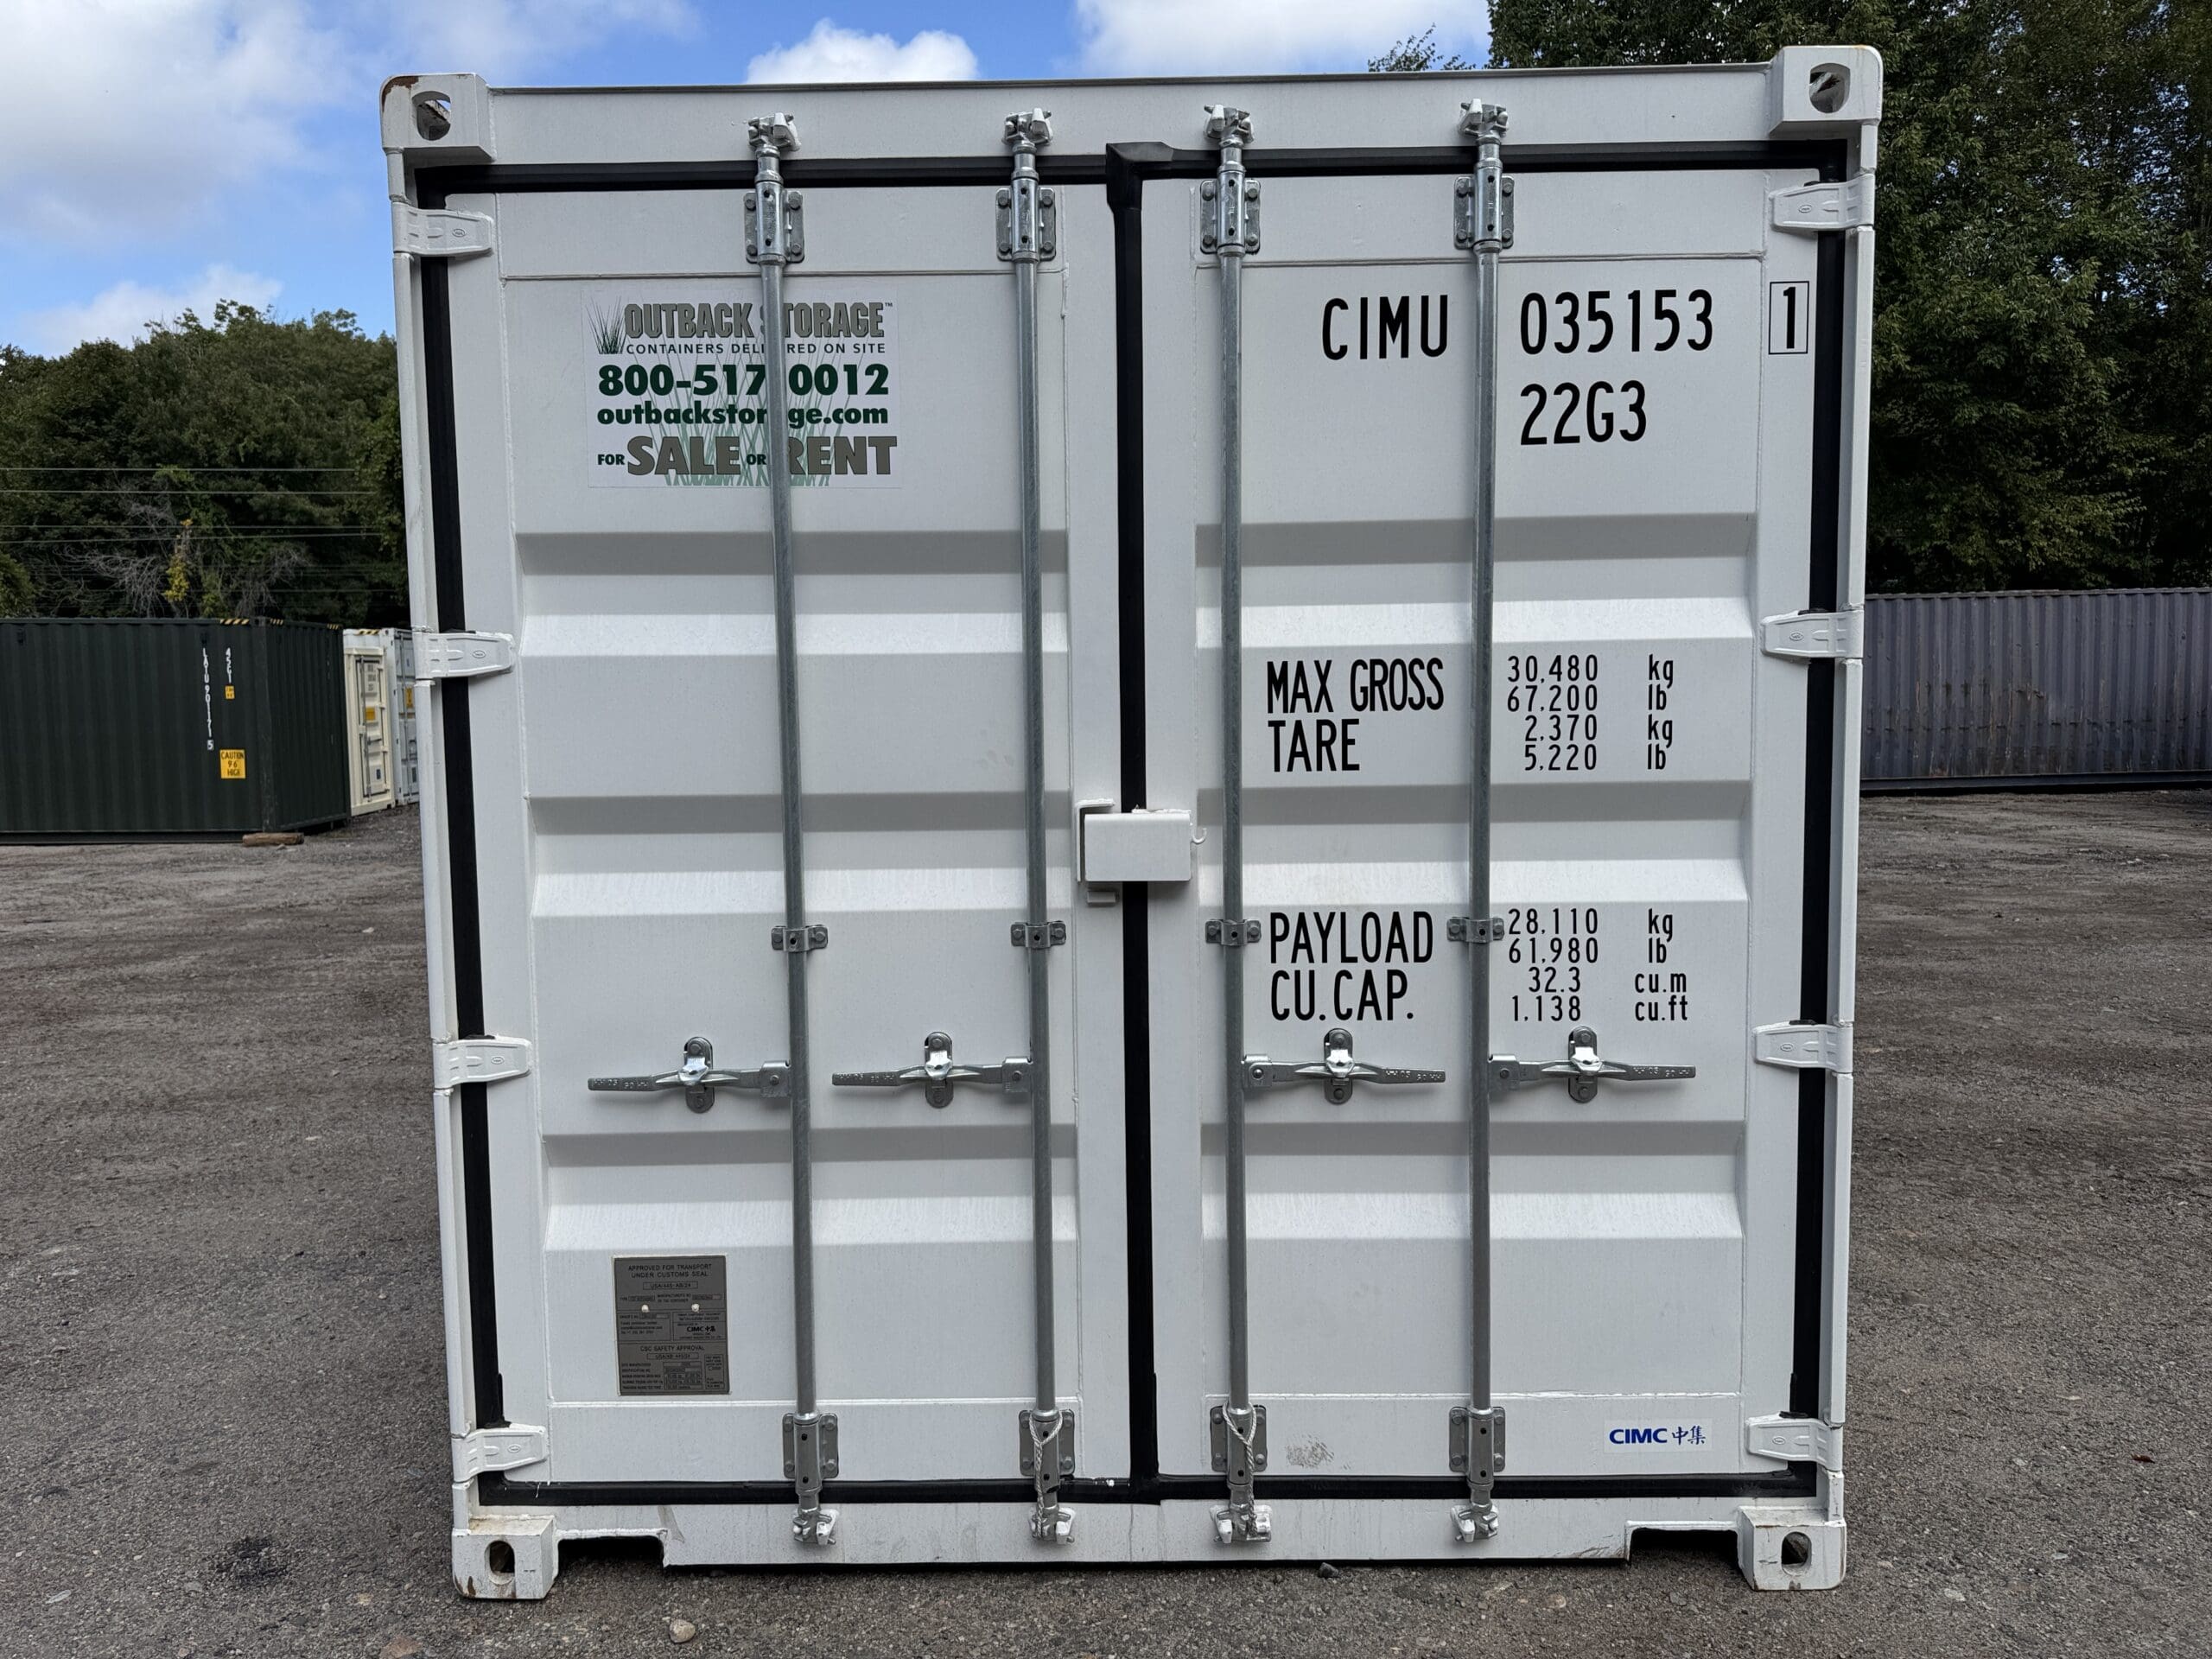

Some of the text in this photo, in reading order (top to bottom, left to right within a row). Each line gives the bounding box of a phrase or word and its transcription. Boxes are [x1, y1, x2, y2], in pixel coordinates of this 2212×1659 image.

[624, 302, 754, 339] OUTBACK
[1322, 286, 1796, 360] CIMU 035153 1
[626, 343, 886, 355] CONTAINERS DELIRED ON SITE
[598, 364, 889, 397] 800-5170012
[597, 400, 888, 429] outbackstorge.com
[1520, 379, 1647, 446] 22G3
[597, 454, 625, 466] FOR
[626, 435, 741, 476] SALE
[747, 454, 767, 466] OR
[1267, 657, 1445, 714] MAX GROSS
[1648, 653, 1674, 689] kg
[1648, 683, 1667, 711] lb
[1268, 718, 1360, 772] TARE
[1647, 713, 1673, 748] kg
[1647, 743, 1667, 771] lb
[1270, 911, 1433, 964] PAYLOAD
[1648, 907, 1673, 943] kg
[1648, 937, 1667, 964] lb
[1271, 969, 1414, 1021] CU.CAP.
[1528, 966, 1687, 994] 32.3 cu.m
[1635, 995, 1688, 1021] cu.ft
[1609, 1425, 1707, 1446] CIMC 中集
